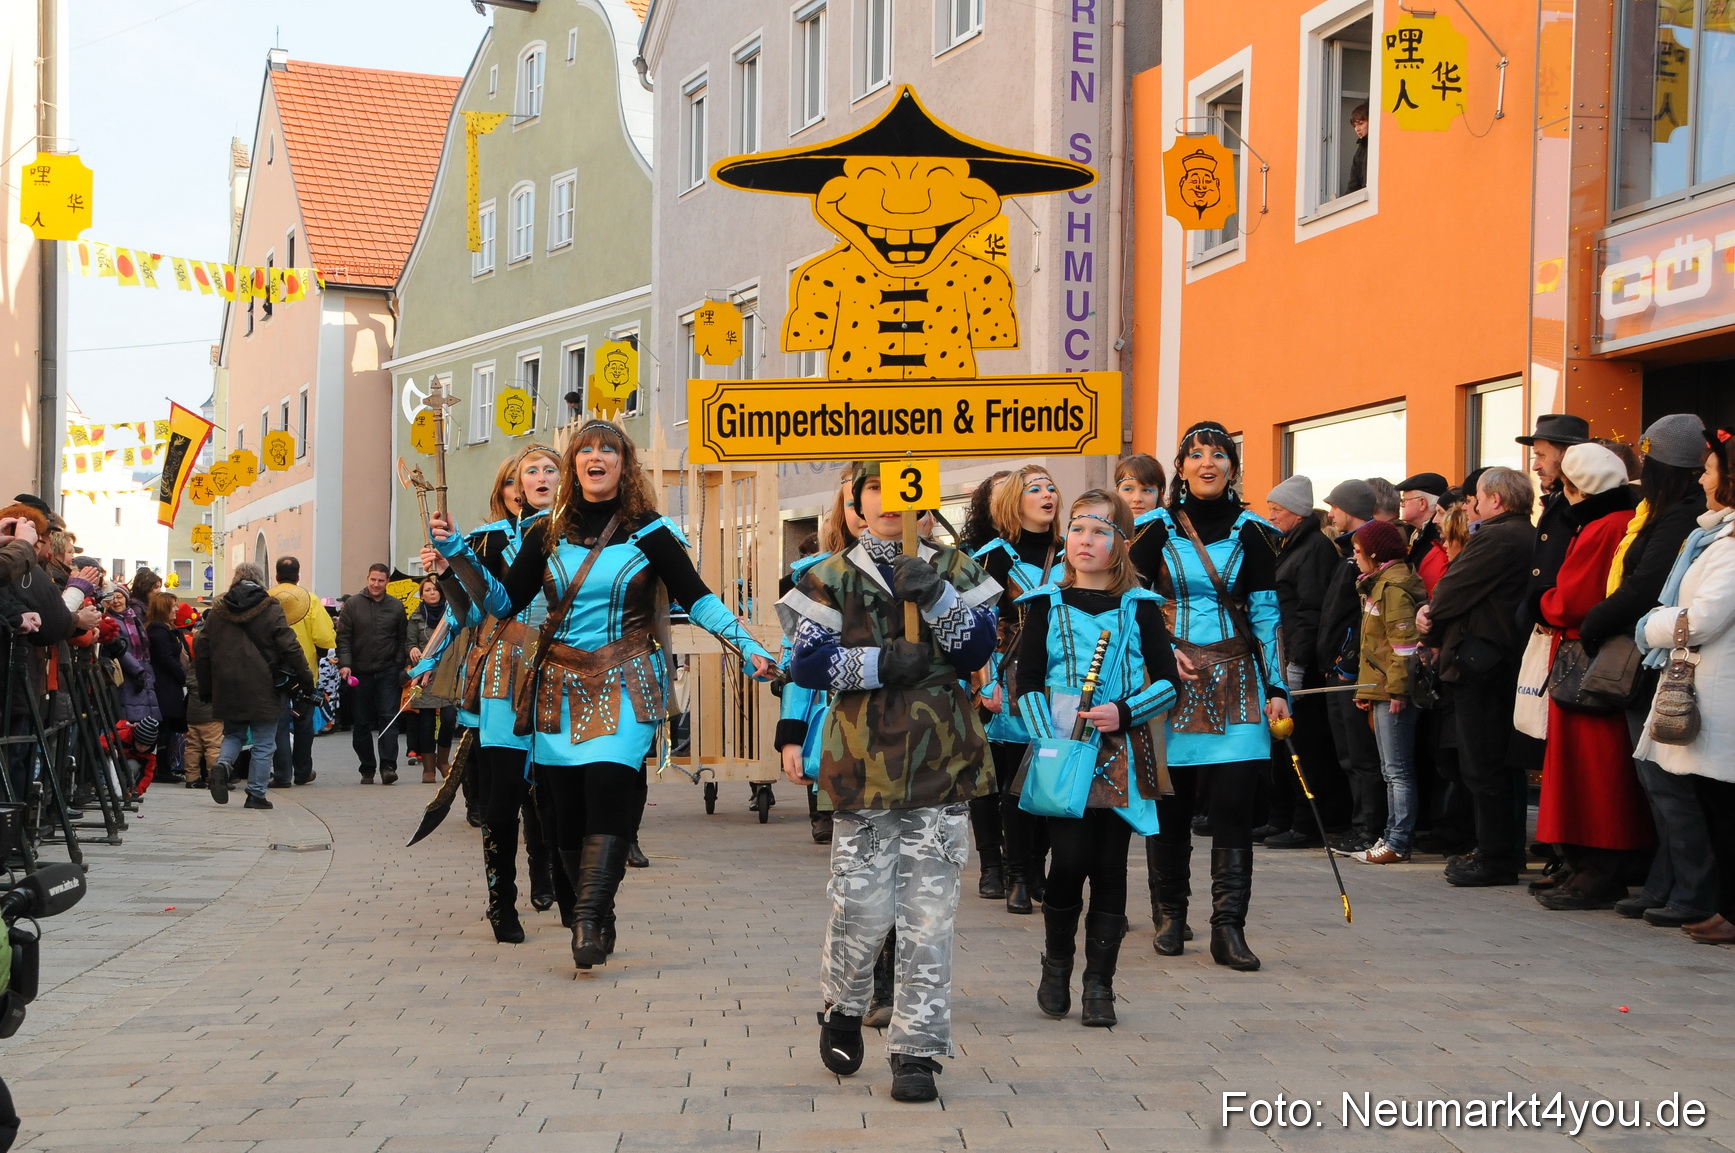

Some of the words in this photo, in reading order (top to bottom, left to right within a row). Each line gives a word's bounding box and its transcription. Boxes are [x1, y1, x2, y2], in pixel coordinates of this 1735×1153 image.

[1432, 61, 1462, 101] 华
[1392, 78, 1419, 113] 人
[66, 193, 84, 213] 华
[30, 211, 46, 227] 人
[984, 233, 1007, 261] 华
[702, 344, 713, 356] 人
[725, 330, 737, 345] 华
[716, 401, 943, 446] Gimpertshausen
[953, 398, 975, 434] &
[985, 397, 1084, 433] Friends
[899, 467, 923, 503] 3
